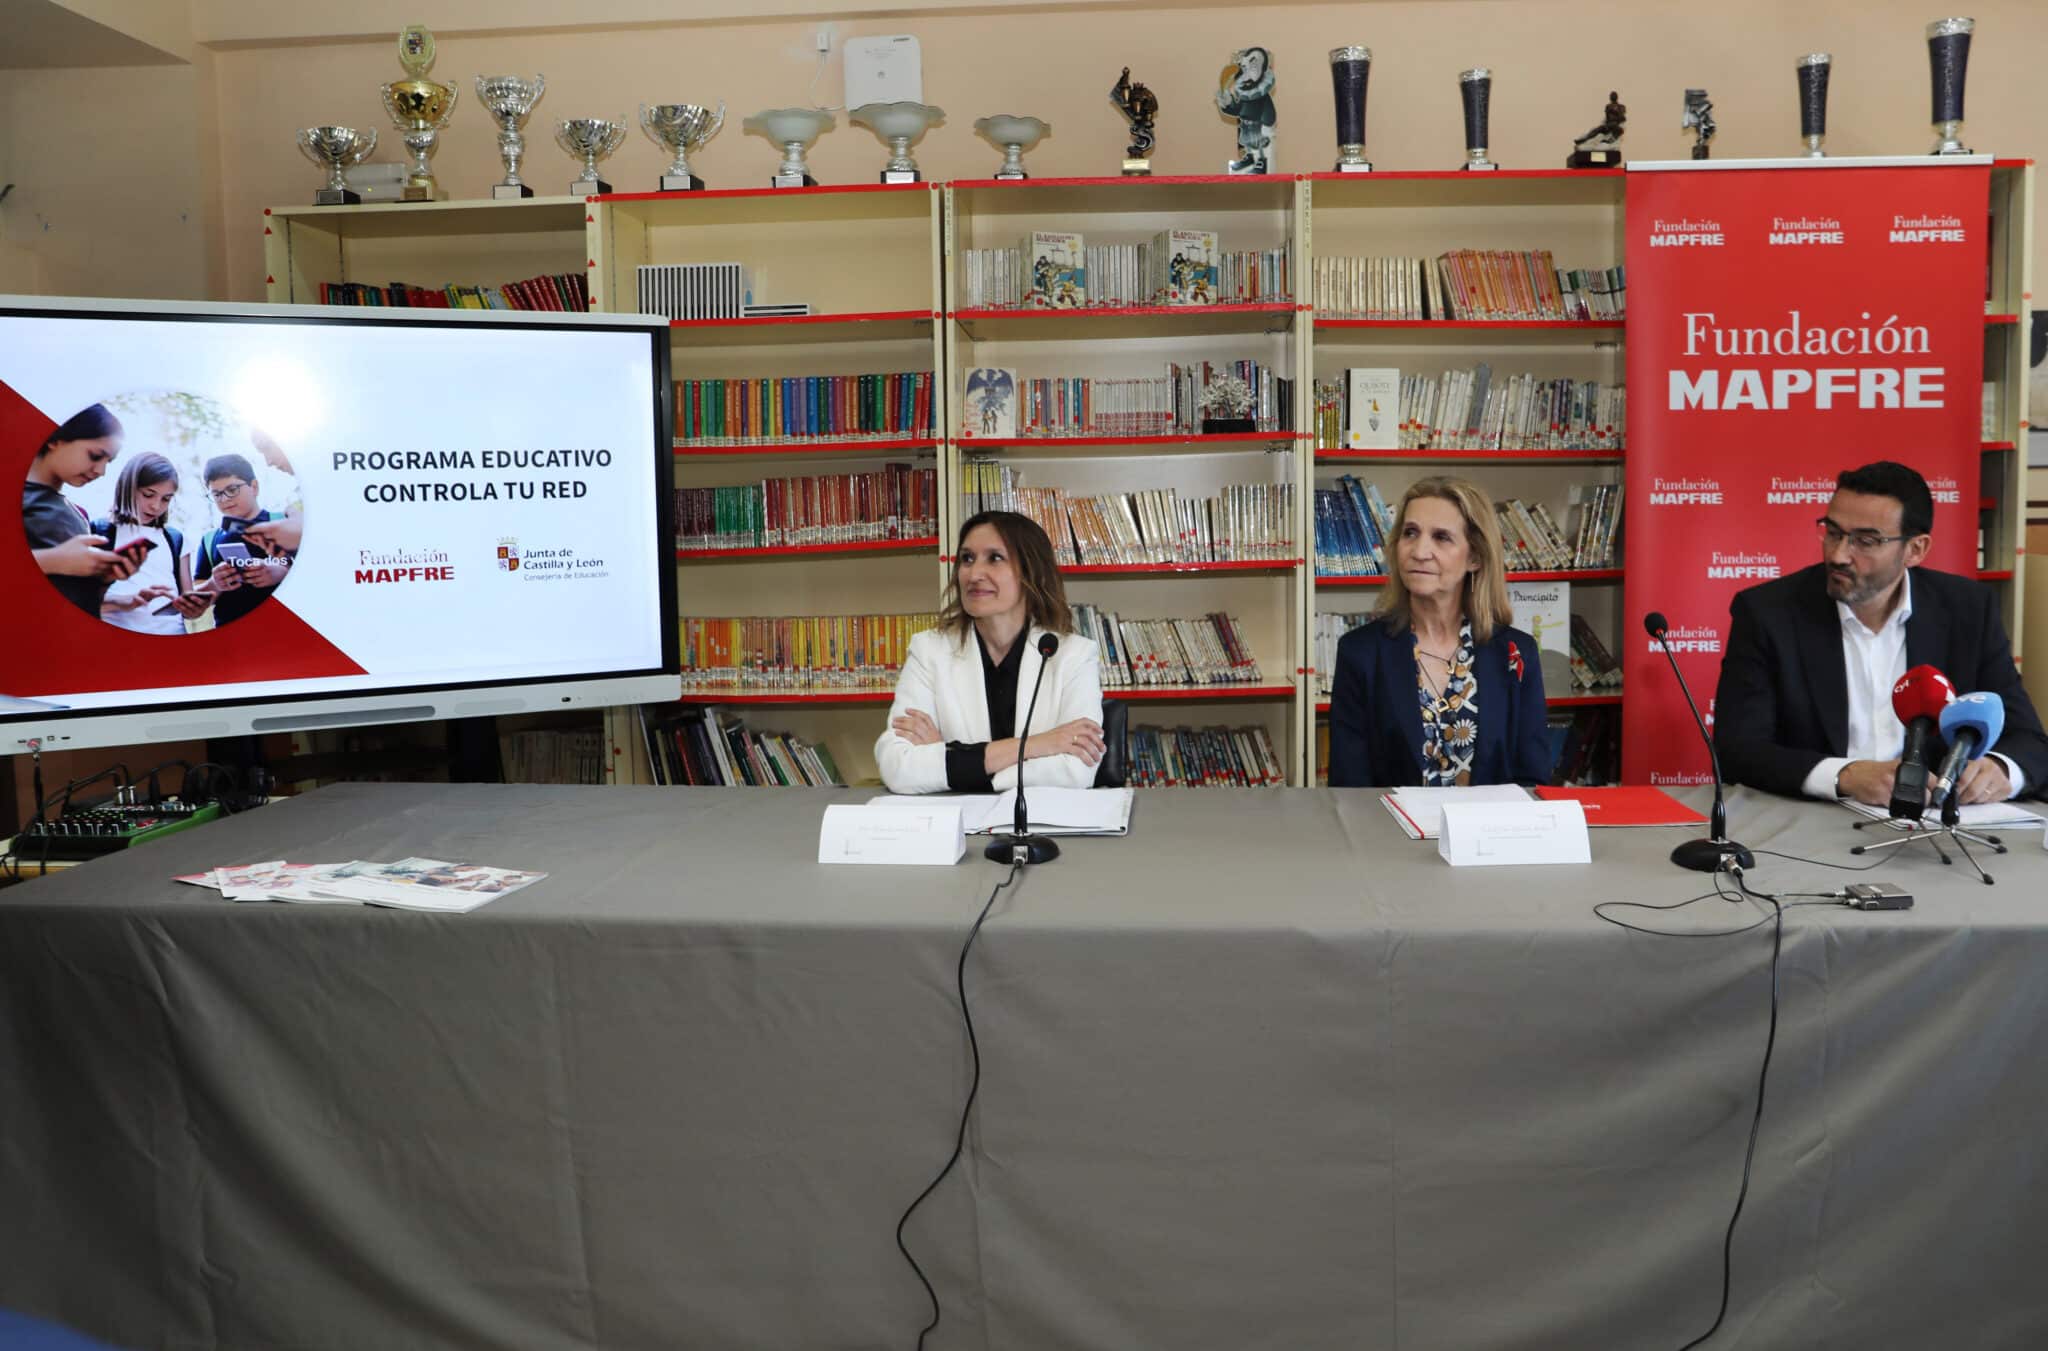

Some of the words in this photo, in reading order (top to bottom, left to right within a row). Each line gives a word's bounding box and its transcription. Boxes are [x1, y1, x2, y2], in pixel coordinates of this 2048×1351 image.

[1654, 219, 1720, 233] Fundación
[1773, 217, 1840, 231] Fundación
[1893, 215, 1961, 229] Fundación
[1649, 233, 1725, 247] MAPFRE
[1769, 231, 1844, 245] MAPFRE
[1889, 229, 1965, 243] MAPFRE
[1682, 310, 1931, 356] Fundación
[1668, 367, 1945, 410] MAPFRE
[333, 451, 475, 470] PROGRAMA
[481, 449, 612, 468] EDUCATIVO
[1654, 477, 1720, 491] Fundación
[1772, 477, 1837, 490] Fundación
[363, 482, 498, 503] CONTROLA
[504, 481, 535, 500] TU
[542, 480, 588, 499] RED
[1649, 492, 1723, 505] MAPFRE
[1767, 492, 1834, 504] MAPFR
[359, 548, 449, 566] Fundación
[524, 549, 556, 559] Junta
[559, 548, 573, 557] de
[1712, 551, 1777, 565] Fundación
[228, 556, 260, 568] Toca
[264, 554, 288, 566] dos
[524, 560, 563, 570] Castilla
[567, 561, 573, 570] y
[576, 558, 604, 568] León
[355, 566, 455, 584] MAPFRE
[563, 572, 573, 580] de
[1708, 566, 1781, 579] MAPFRE
[1665, 625, 1717, 638] ndación
[1648, 640, 1721, 653] MAPFRE
[1650, 771, 1714, 785] Fundación
